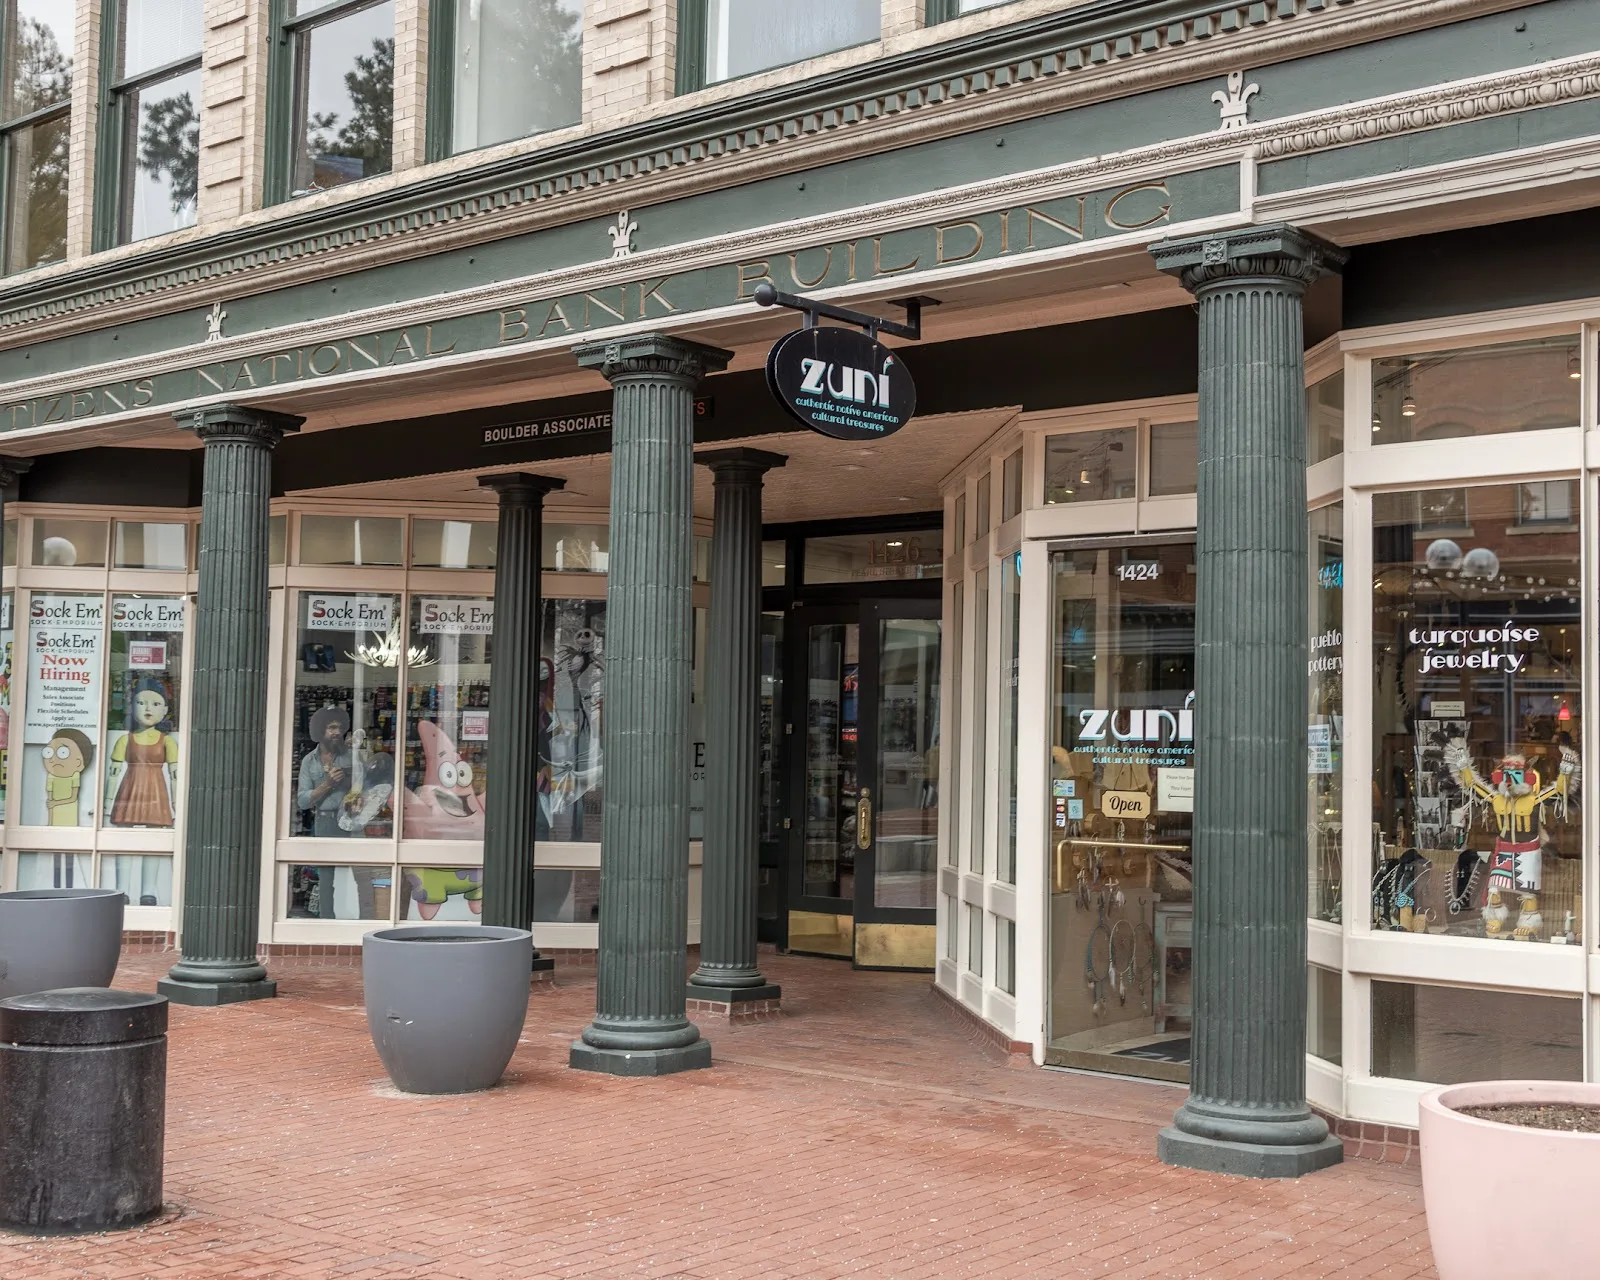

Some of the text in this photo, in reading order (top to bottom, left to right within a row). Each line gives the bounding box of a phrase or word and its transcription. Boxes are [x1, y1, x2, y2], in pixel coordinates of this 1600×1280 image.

[196, 325, 459, 397] NATIONAL
[498, 277, 682, 345] BANK
[735, 181, 1173, 300] BUILDING
[795, 397, 899, 424] authentic native american
[484, 421, 539, 443] BOULDER
[542, 413, 614, 435] ASSOCIATE
[811, 412, 885, 432] cultural treasures
[1117, 563, 1159, 582] 1424
[31, 600, 71, 618] Sock
[113, 603, 154, 621] Sock
[312, 600, 354, 619] Sock
[424, 603, 466, 623] Sock
[36, 631, 71, 648] Sock
[1311, 629, 1342, 653] pueblo
[1409, 620, 1540, 648] turquoise
[42, 654, 89, 666] Now
[1308, 655, 1343, 677] pottery
[1418, 647, 1525, 674] jewelry
[39, 667, 91, 685] Hiring
[43, 685, 86, 693] Management
[1073, 744, 1120, 754] authentic
[1122, 744, 1155, 754] native
[1092, 755, 1186, 766] cultural treasures
[1109, 795, 1142, 815] Open
